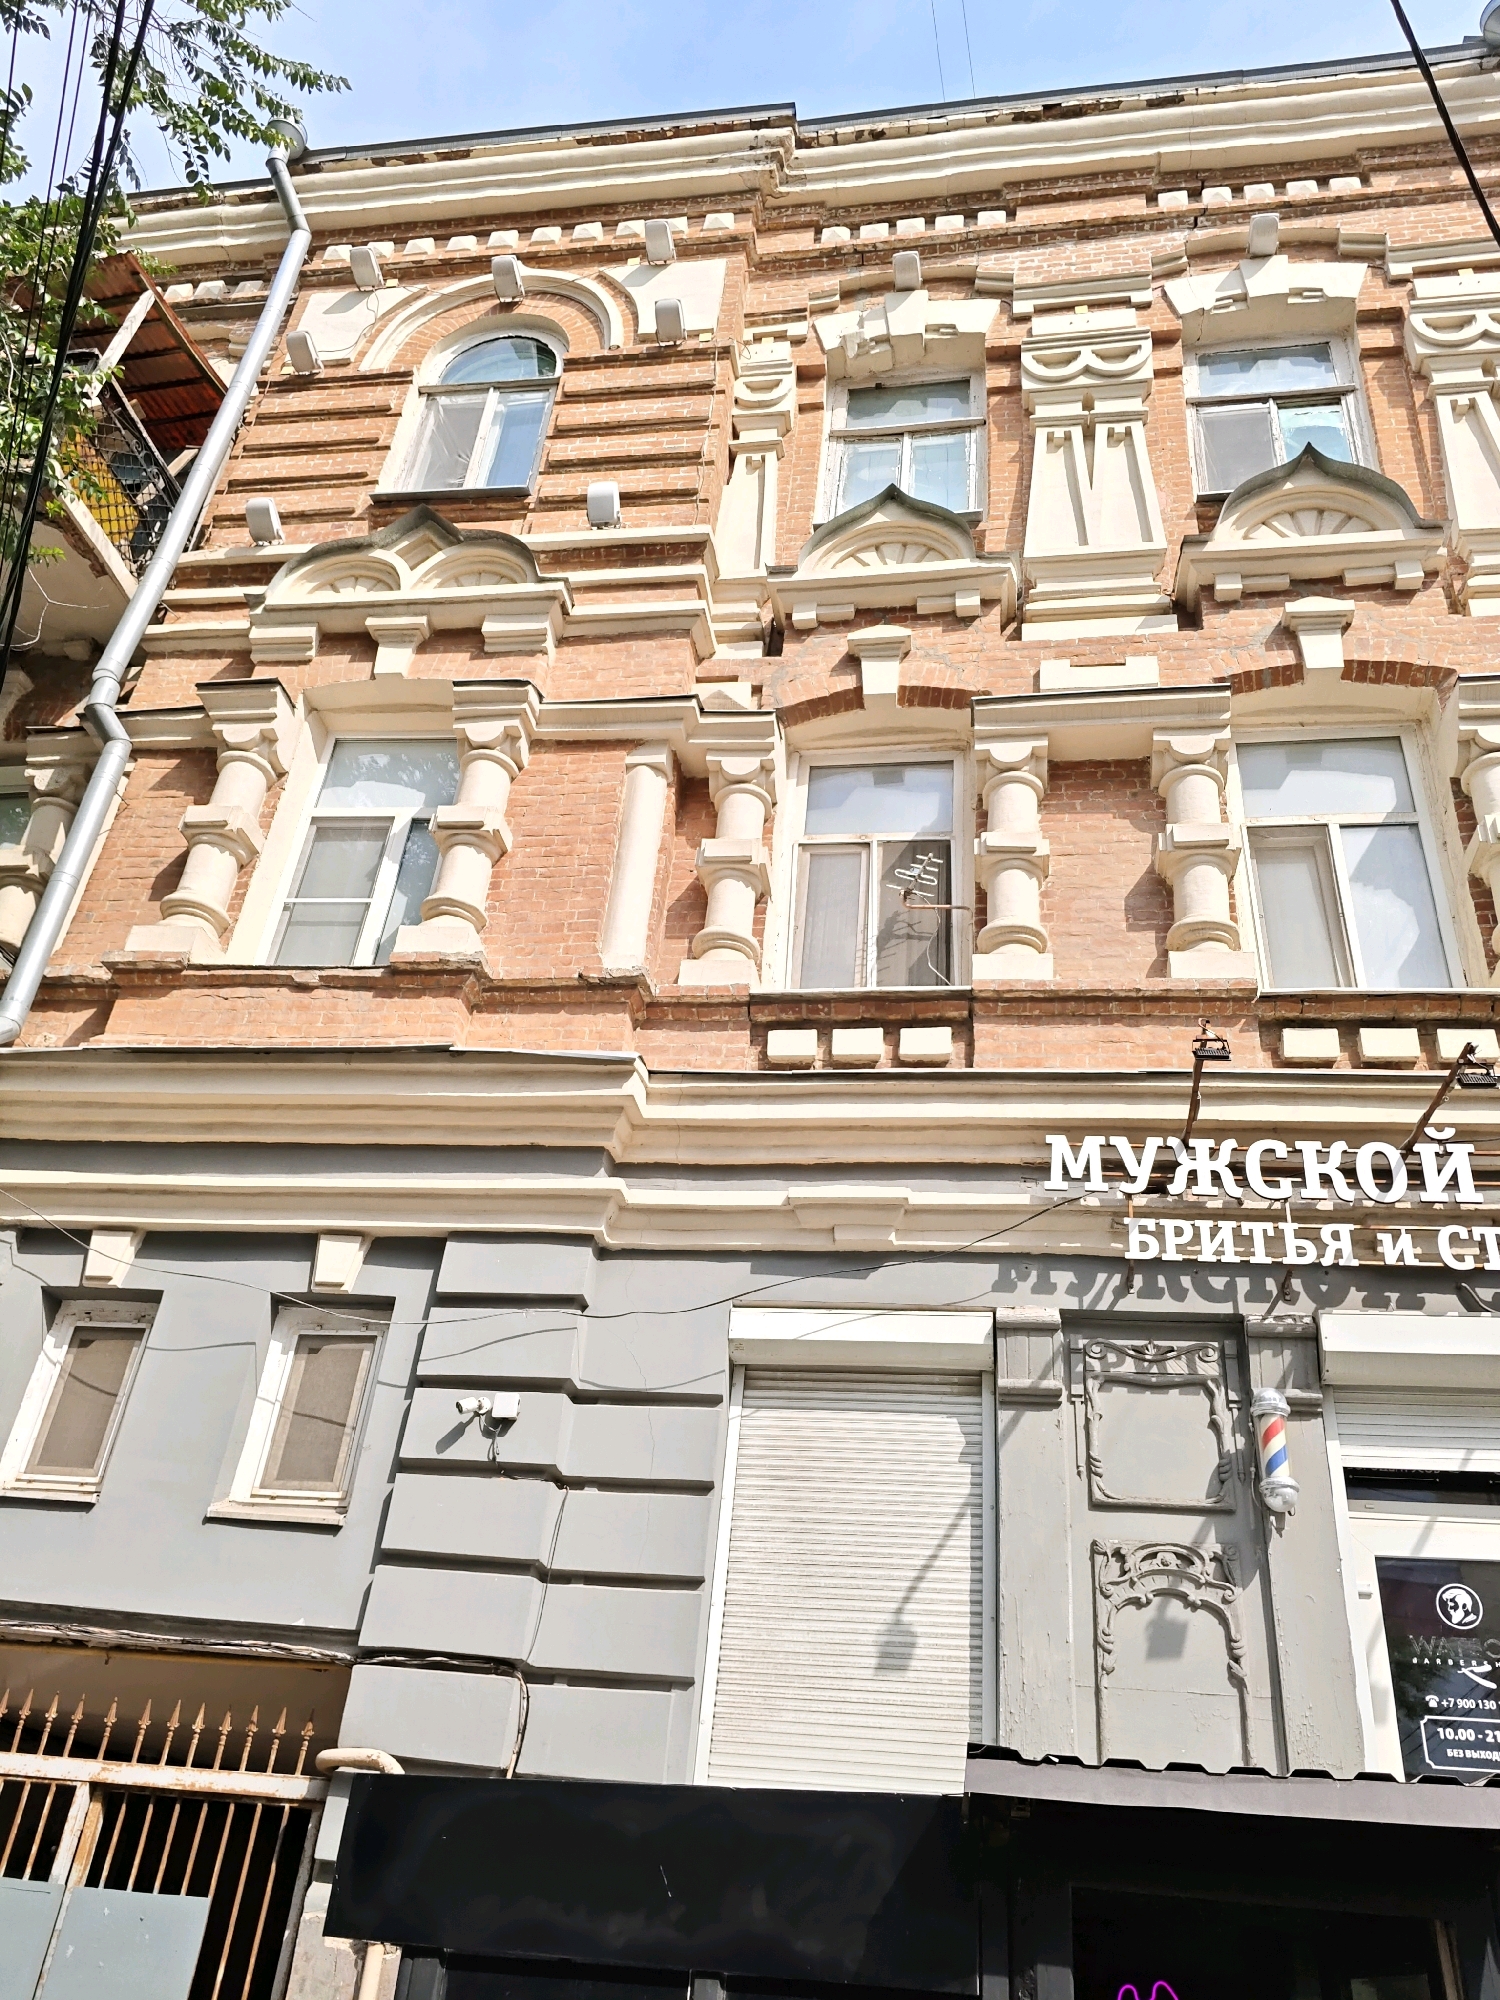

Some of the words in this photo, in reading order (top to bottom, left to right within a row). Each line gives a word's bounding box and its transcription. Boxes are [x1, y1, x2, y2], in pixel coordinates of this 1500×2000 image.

[1044, 1126, 1484, 1204] МУЖСКОЙ
[1123, 1217, 1360, 1267] БРИТЬЯ
[1376, 1228, 1420, 1266] и
[1437, 1224, 1500, 1271] СТ
[1441, 1697, 1455, 1708] +7
[1456, 1698, 1476, 1709] 900
[1477, 1699, 1497, 1710] 130
[1436, 1727, 1476, 1741] 10.00
[1446, 1748, 1464, 1758] БЕЗ
[1464, 1749, 1500, 1762] ВЫХОД
